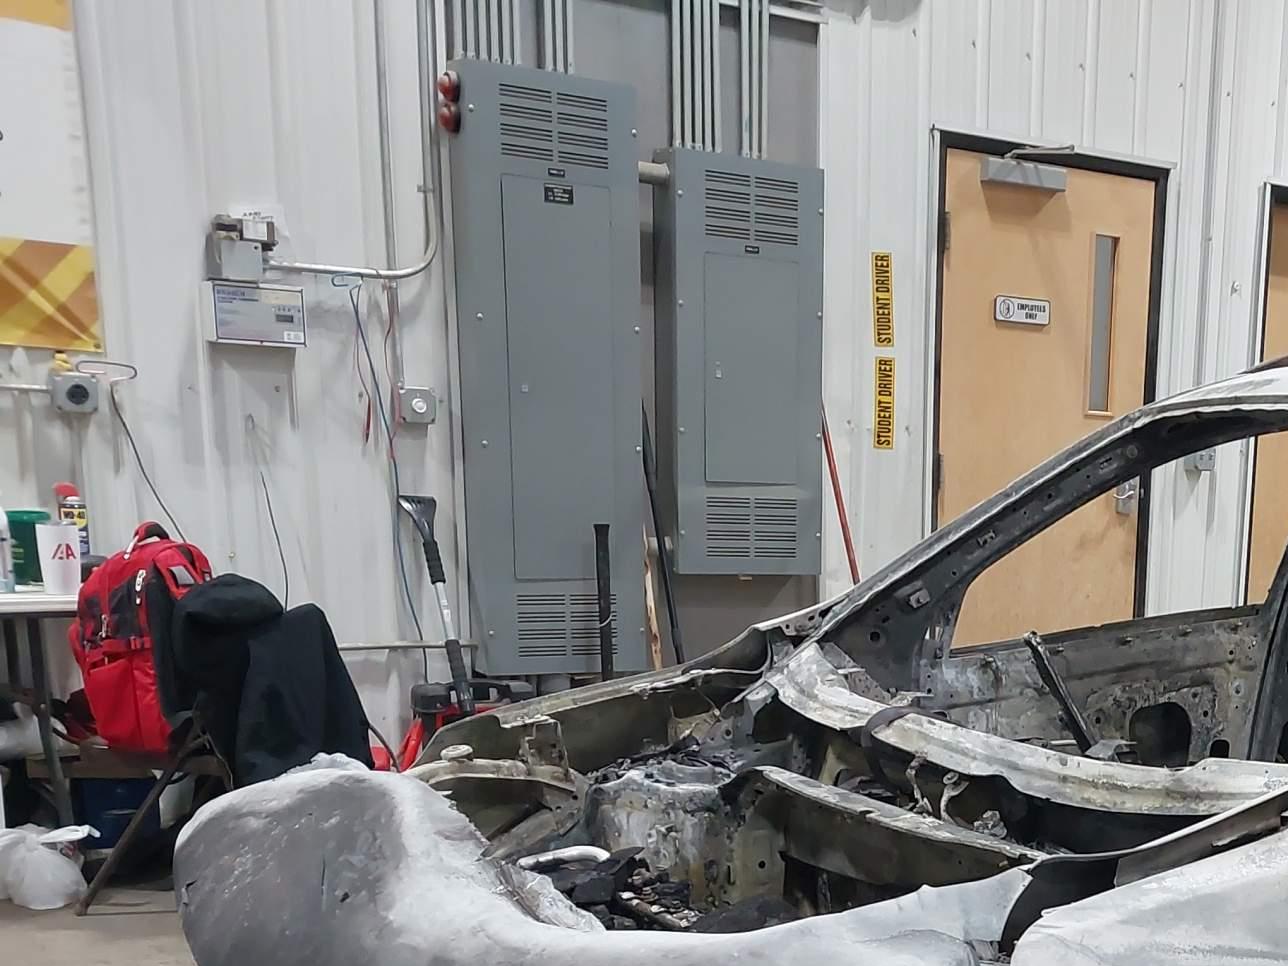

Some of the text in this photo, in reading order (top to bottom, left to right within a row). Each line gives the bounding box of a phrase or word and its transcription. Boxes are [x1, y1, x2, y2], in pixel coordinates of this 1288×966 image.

[875, 255, 892, 344] STUDENT DRIVER
[1017, 303, 1046, 313] EMPLOYEES
[1025, 312, 1037, 320] ONLY
[877, 359, 893, 446] STUDENT DRIVER
